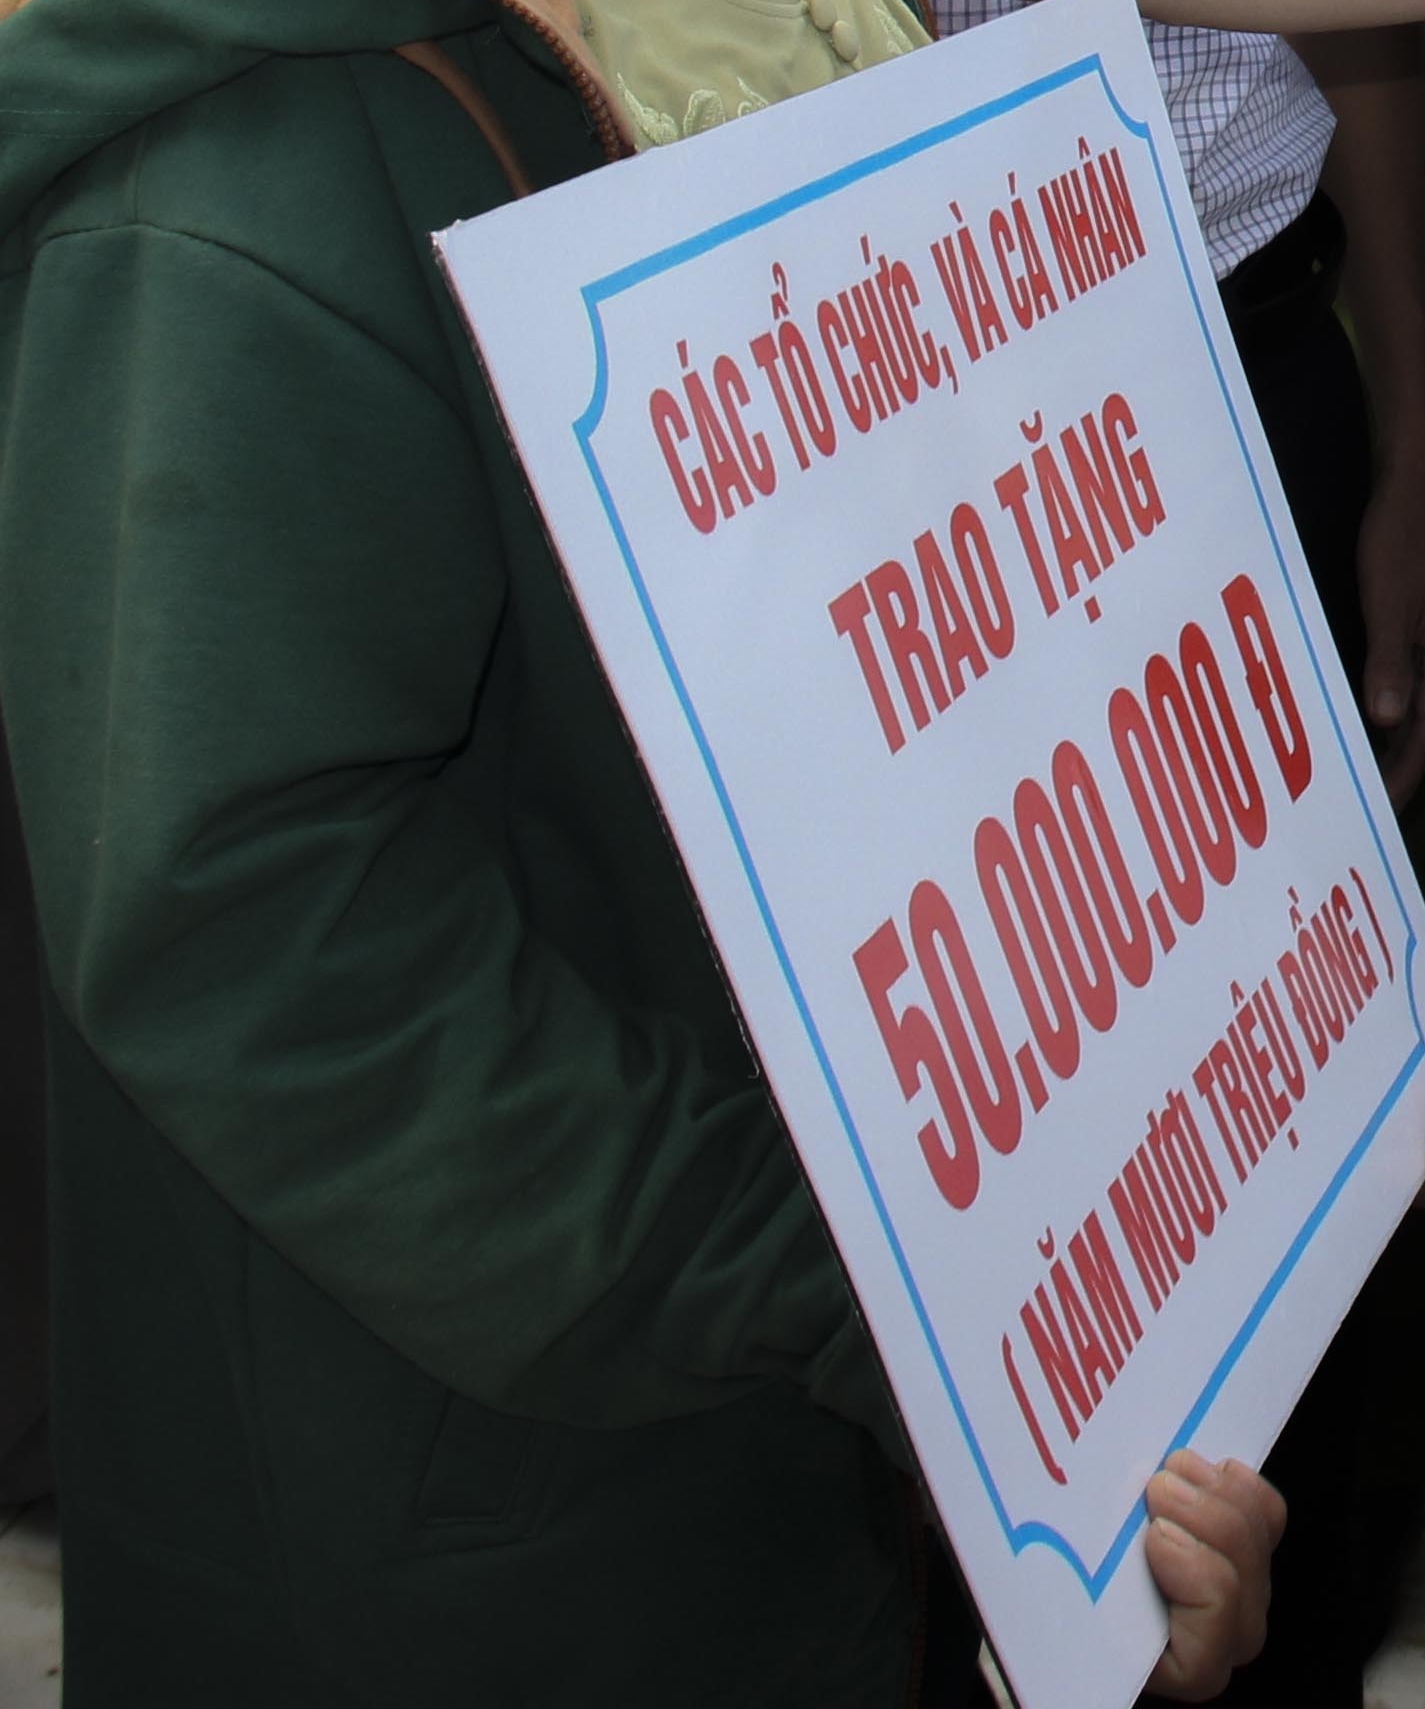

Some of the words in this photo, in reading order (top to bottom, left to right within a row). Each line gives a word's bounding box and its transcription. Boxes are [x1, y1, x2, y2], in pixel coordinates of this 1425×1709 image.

[648, 337, 778, 537] CÁC
[751, 259, 838, 471] TỔ
[816, 234, 960, 435] CHỨC,
[930, 200, 1010, 364] VÀ
[988, 171, 1060, 332] CÁ
[1036, 134, 1148, 301] NHÂN
[829, 502, 1017, 753] TRAO
[994, 392, 1167, 625] TẶNG
[853, 621, 1269, 1212] 50.000.000
[1221, 573, 1314, 801] Đ
[1278, 884, 1378, 1072] ĐỒNG
[1348, 865, 1395, 986] )
[1192, 979, 1306, 1185] TRIỆU
[1107, 1087, 1229, 1314] MƯƠI
[1002, 1332, 1067, 1484] (
[1020, 1210, 1144, 1443] NĂM
